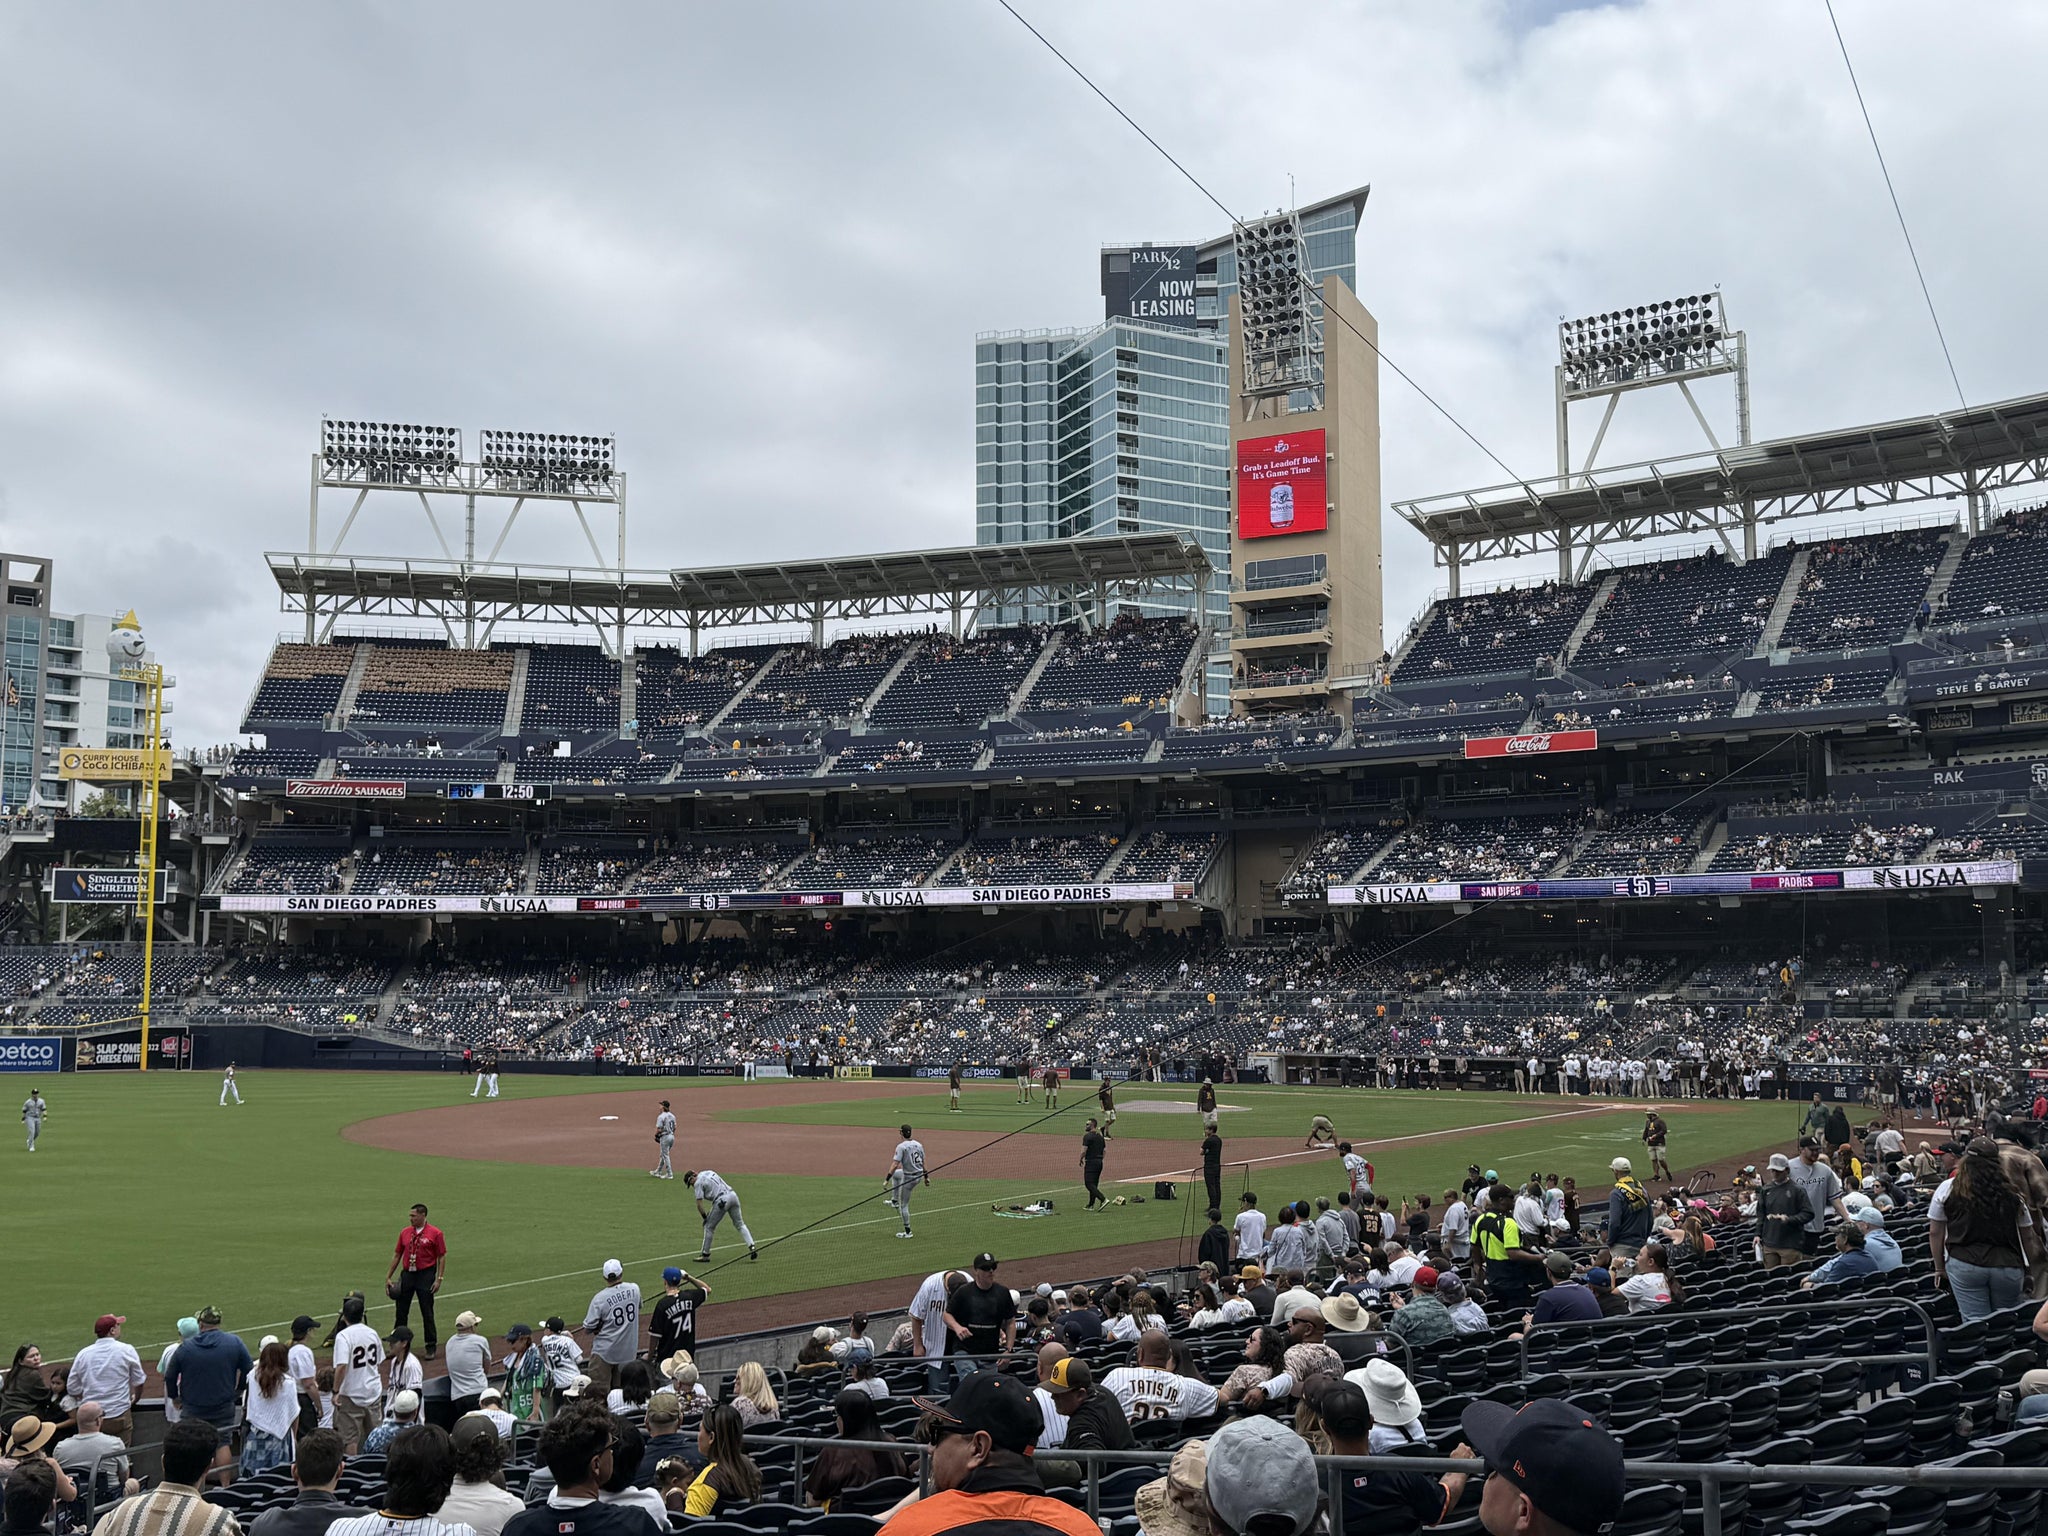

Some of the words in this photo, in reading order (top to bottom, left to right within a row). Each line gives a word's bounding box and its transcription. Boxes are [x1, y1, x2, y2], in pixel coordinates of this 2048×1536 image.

[1132, 251, 1170, 263] PARK
[1166, 259, 1181, 270] 12
[1160, 280, 1194, 298] NOW
[1131, 299, 1195, 317] LEASING
[1243, 463, 1262, 472] Grab
[1270, 457, 1301, 469] Leadoff
[1302, 455, 1320, 465] Bud.
[1266, 469, 1289, 478] Game
[1290, 466, 1311, 475] Time
[1936, 684, 1969, 696] STEVE
[1975, 682, 1983, 692] 6
[1989, 677, 2030, 690] GARVEY
[2013, 702, 2042, 715] 97.3
[1930, 719, 1951, 729] 860
[1505, 735, 1552, 753] Coca-Cola
[82, 754, 110, 762] CURRY
[111, 754, 139, 763] HOUSE
[82, 761, 108, 770] CoCo
[111, 762, 167, 771] ICHIBANA
[1934, 770, 1964, 784] RAK
[289, 781, 353, 795] Tarantino
[355, 787, 404, 796] SAUSAGES
[501, 785, 534, 798] 12:50
[88, 873, 148, 884] SINGLETON
[1779, 876, 1814, 888] PADRES
[1905, 867, 1968, 888] USAA
[87, 882, 148, 893] SCHREIBER
[972, 889, 1001, 901] SAN
[1005, 888, 1050, 901] DIEGO
[1053, 887, 1111, 900] PADRES
[1481, 886, 1497, 897] SAN
[1498, 885, 1521, 896] DIEGO
[800, 894, 824, 905] PADRES
[883, 891, 925, 906] USAA
[1380, 887, 1429, 903] USAA
[287, 898, 320, 910] SAN
[323, 898, 372, 910] DIEGO
[376, 898, 437, 910] PADRES
[504, 899, 548, 912] USAA
[594, 900, 608, 909] SAN
[608, 899, 626, 909] DIEGO
[96, 1043, 118, 1054] SLAP
[118, 1043, 141, 1054] SOME
[96, 1054, 122, 1064] CHEESE
[122, 1054, 133, 1063] ON
[133, 1053, 141, 1063] IT
[927, 1067, 950, 1077] petc
[974, 1067, 1000, 1077] petco
[606, 1289, 636, 1306] ROBERT
[612, 1303, 635, 1327] 88
[664, 1299, 693, 1319] JIMÉNEZ
[672, 1312, 693, 1340] 74
[353, 1343, 378, 1369] 23
[548, 1354, 564, 1370] 12
[1129, 1379, 1165, 1397] TATIS
[1164, 1386, 1179, 1405] JR.
[519, 1393, 533, 1406] 55
